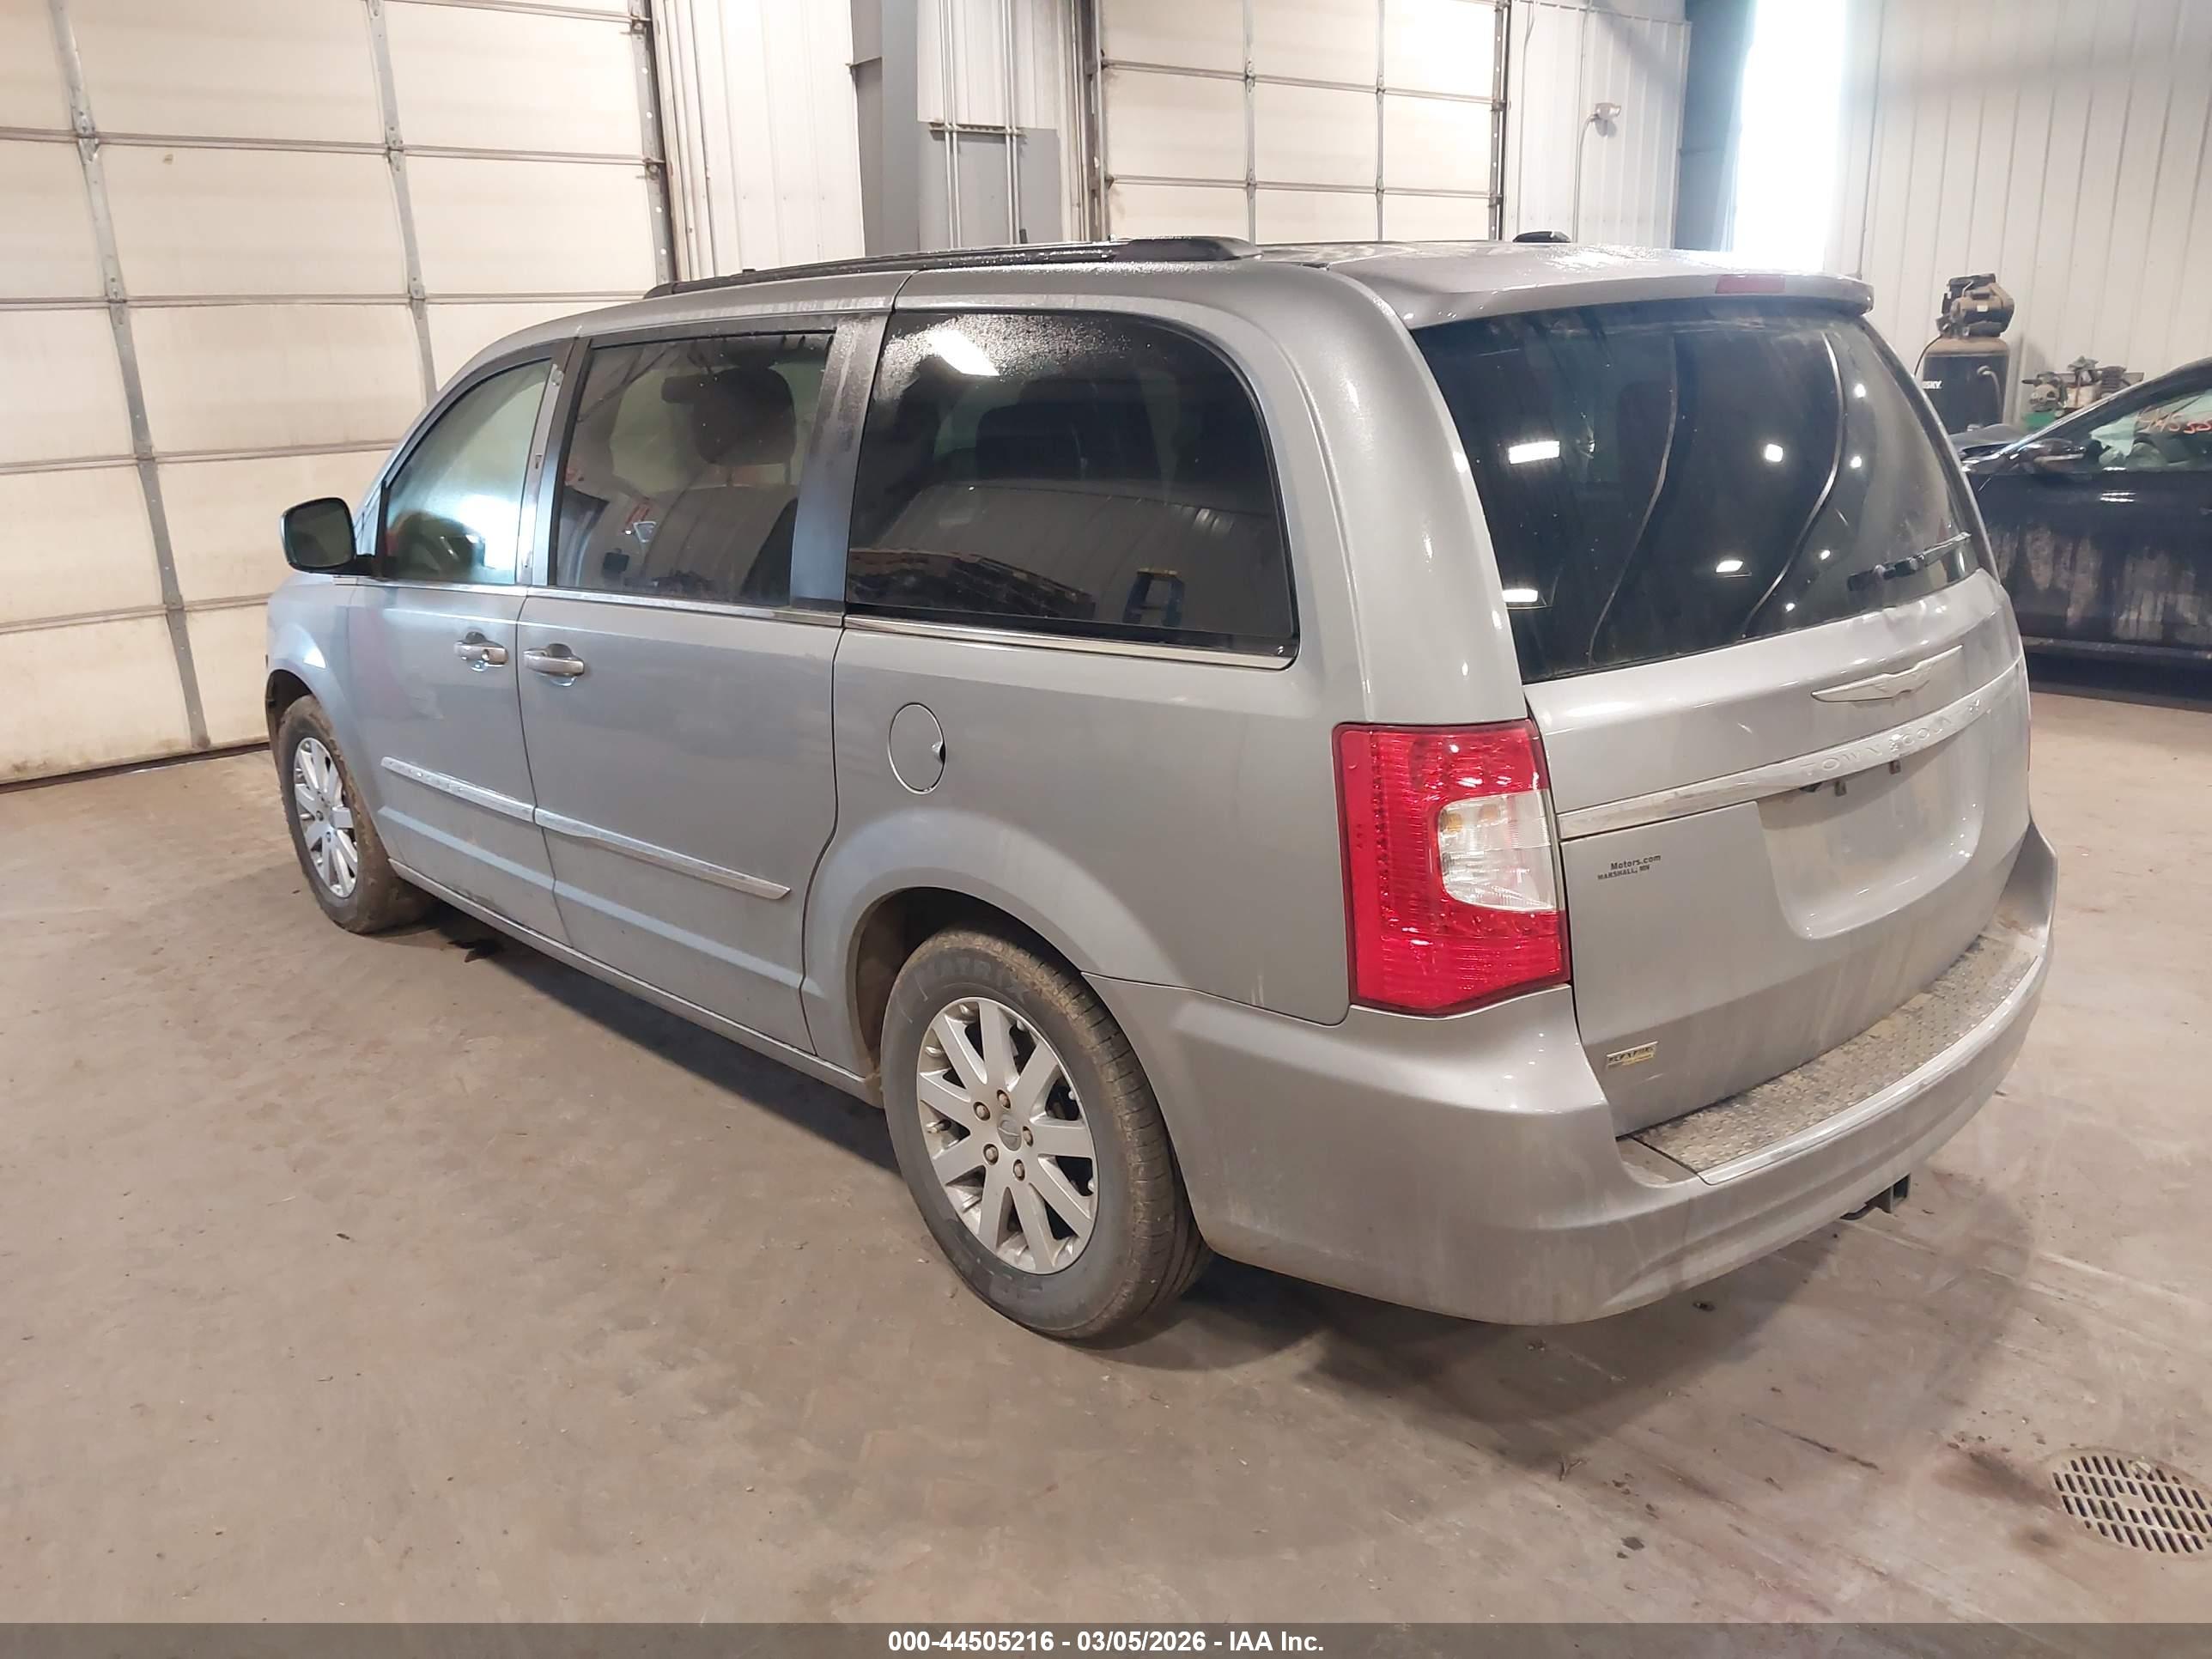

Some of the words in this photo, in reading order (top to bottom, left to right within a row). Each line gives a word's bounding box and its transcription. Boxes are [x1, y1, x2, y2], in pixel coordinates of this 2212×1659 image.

[1923, 380, 1942, 389] SKY
[1903, 699, 1981, 744] COUNY
[1611, 854, 1661, 869] Motors.com
[1597, 868, 1638, 879] MARSHALL,
